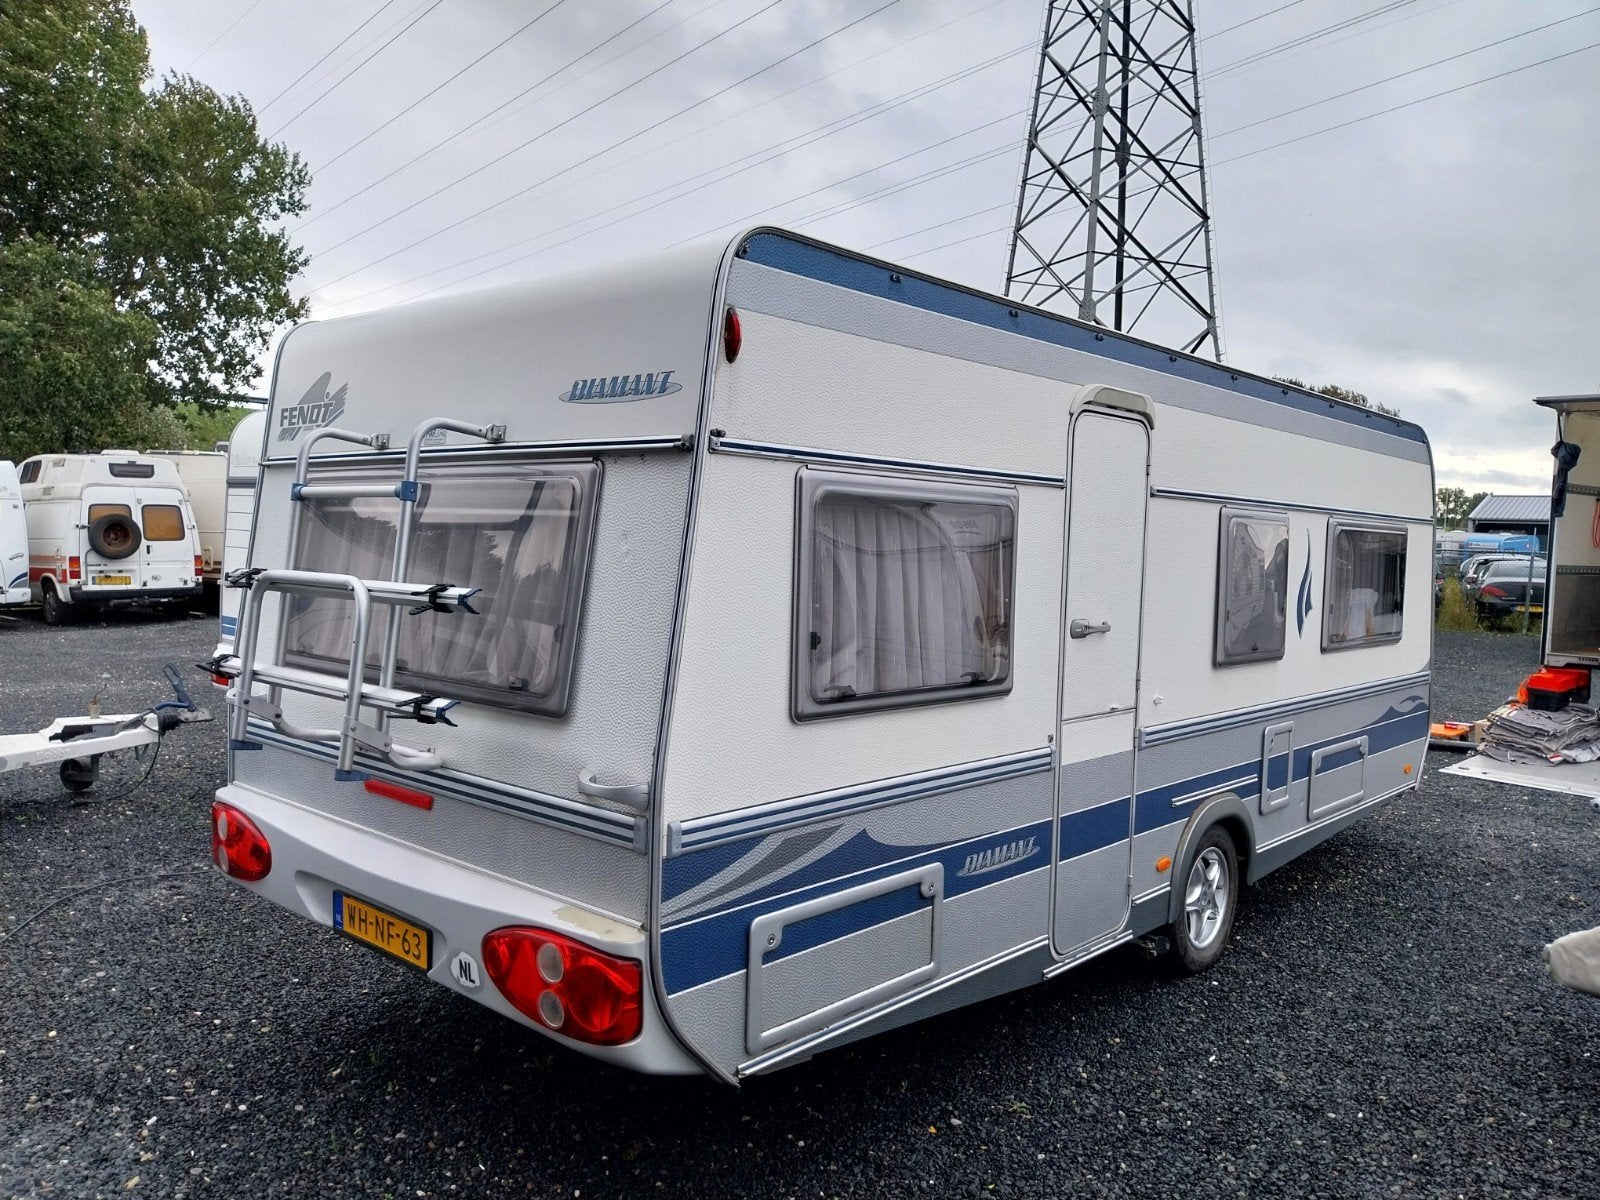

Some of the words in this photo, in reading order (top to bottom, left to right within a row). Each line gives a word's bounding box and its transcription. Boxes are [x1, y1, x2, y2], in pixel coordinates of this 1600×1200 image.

[567, 370, 676, 402] DIAMANT
[279, 402, 334, 428] FENDT
[963, 835, 1037, 874] DIAMANT
[347, 902, 422, 961] WH-NF-63
[458, 958, 476, 984] NL
